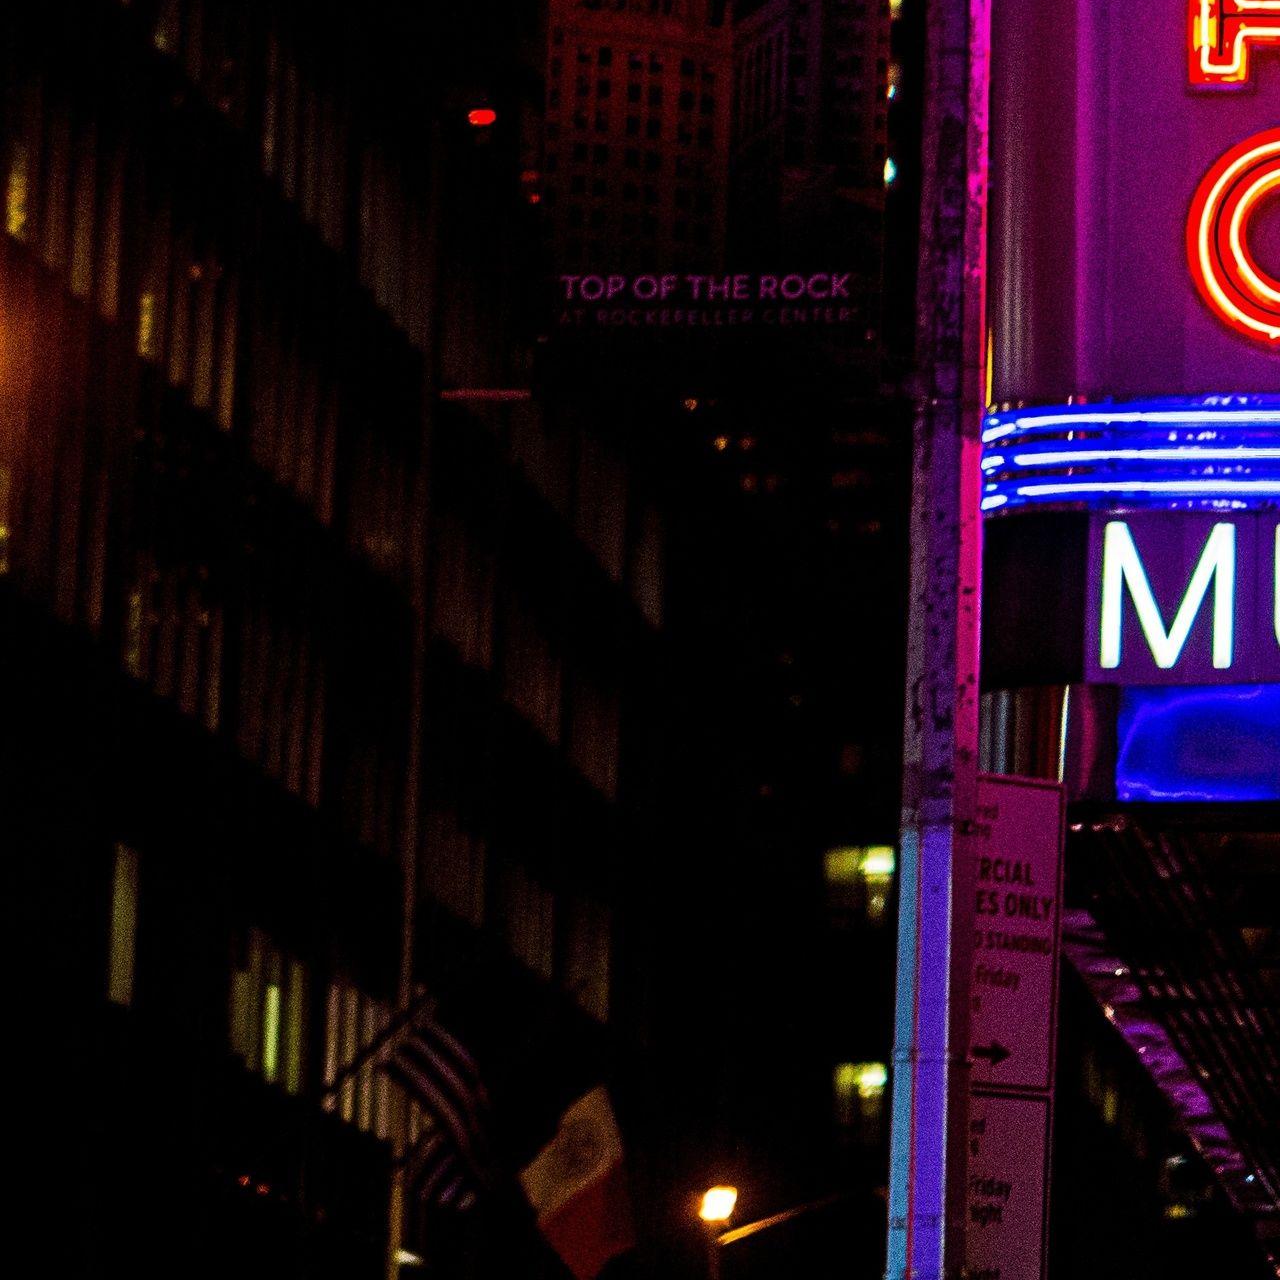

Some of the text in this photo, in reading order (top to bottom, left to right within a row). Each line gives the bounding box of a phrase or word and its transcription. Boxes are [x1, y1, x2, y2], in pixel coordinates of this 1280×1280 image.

[560, 272, 851, 301] TOP OF THE ROCK
[1004, 891, 1054, 920] ONLY
